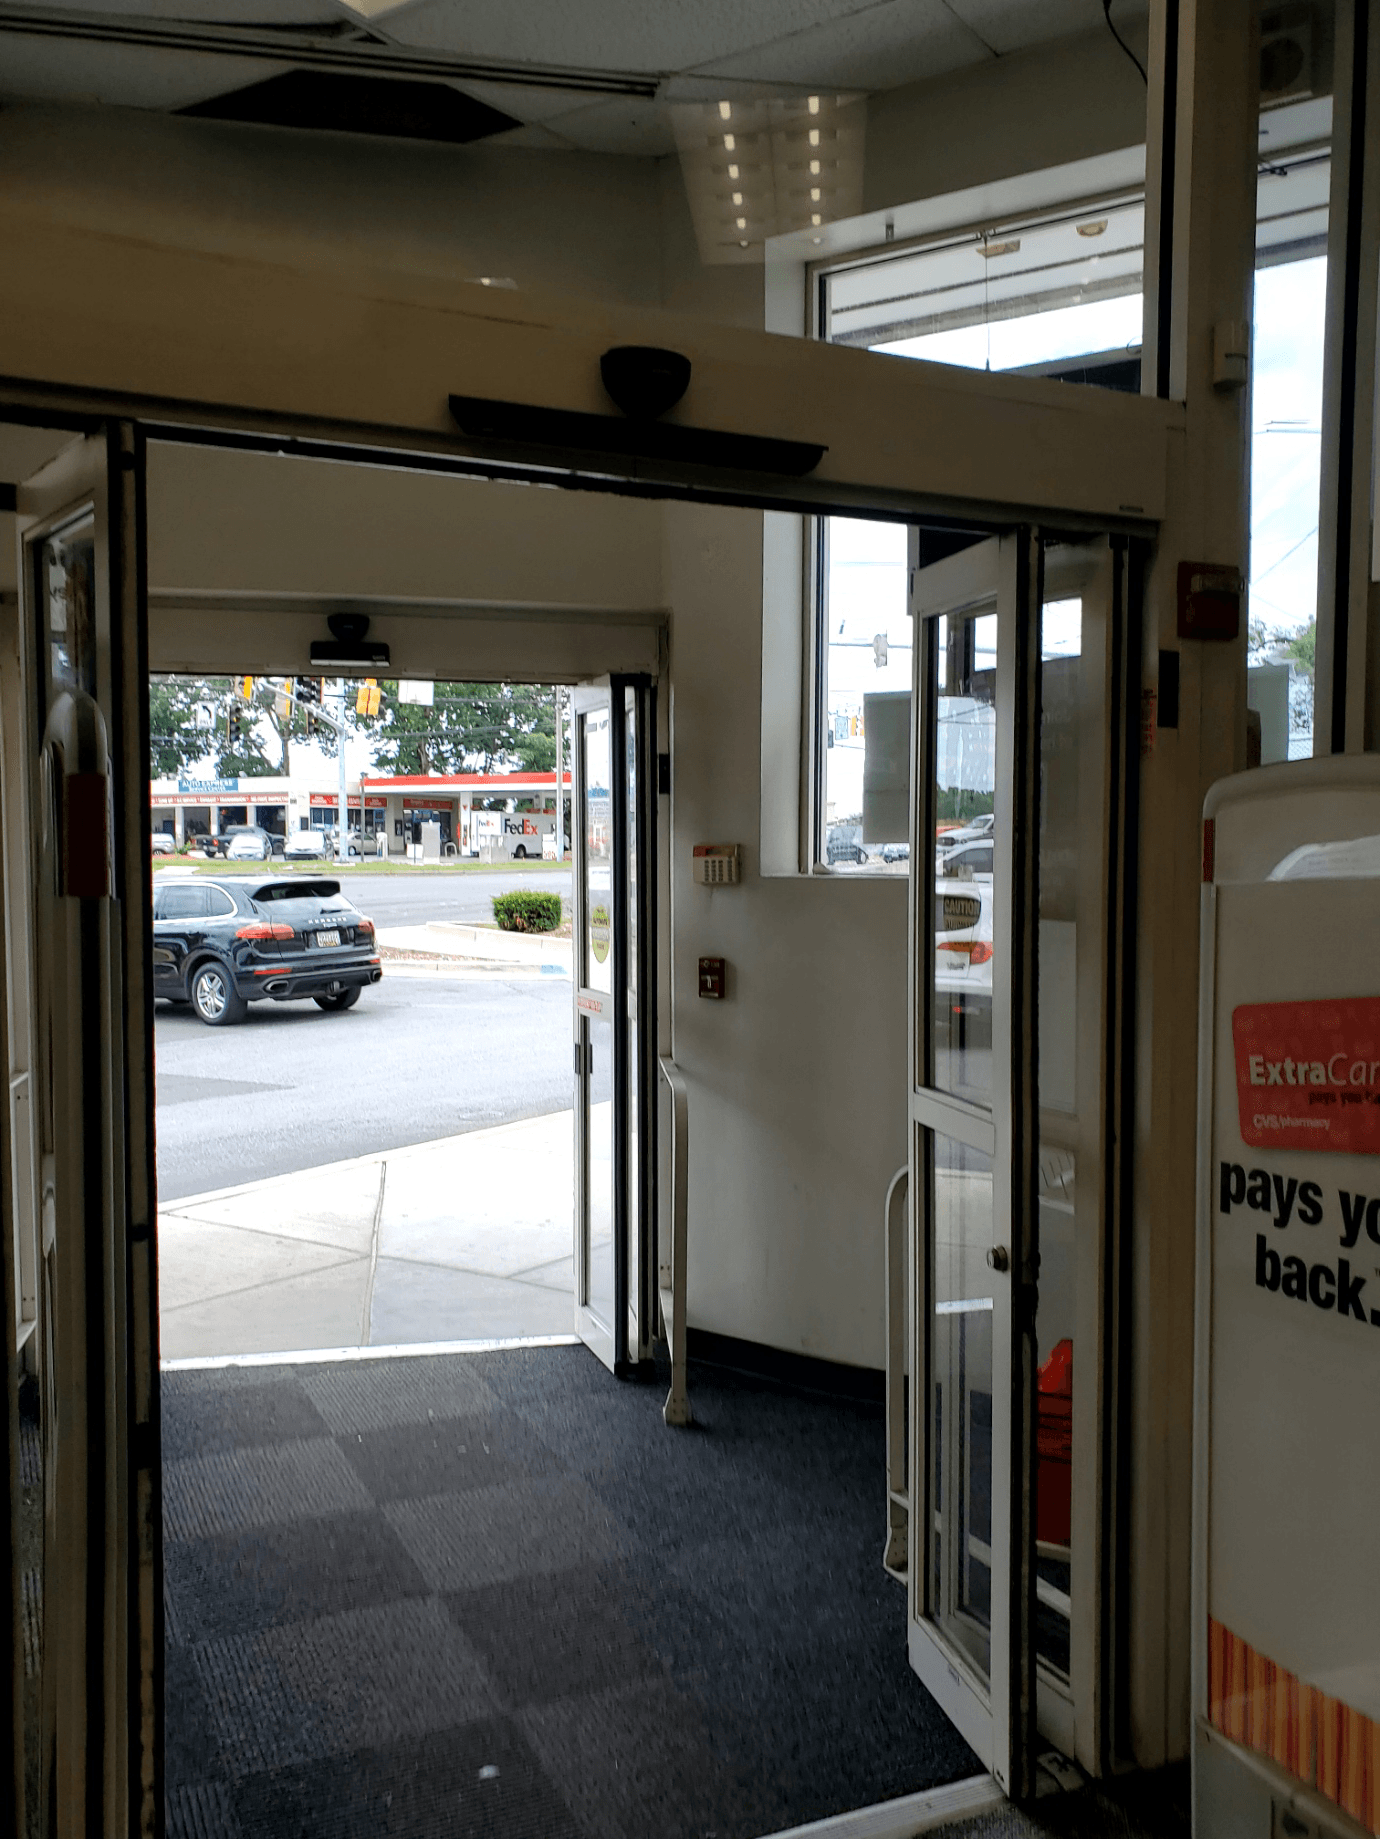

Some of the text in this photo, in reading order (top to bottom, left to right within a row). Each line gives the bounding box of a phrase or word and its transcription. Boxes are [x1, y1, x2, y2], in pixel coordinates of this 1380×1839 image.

[504, 818, 538, 835] FedEx
[1253, 1113, 1330, 1131] CVS/pharmacy
[1219, 1160, 1323, 1230] pays
